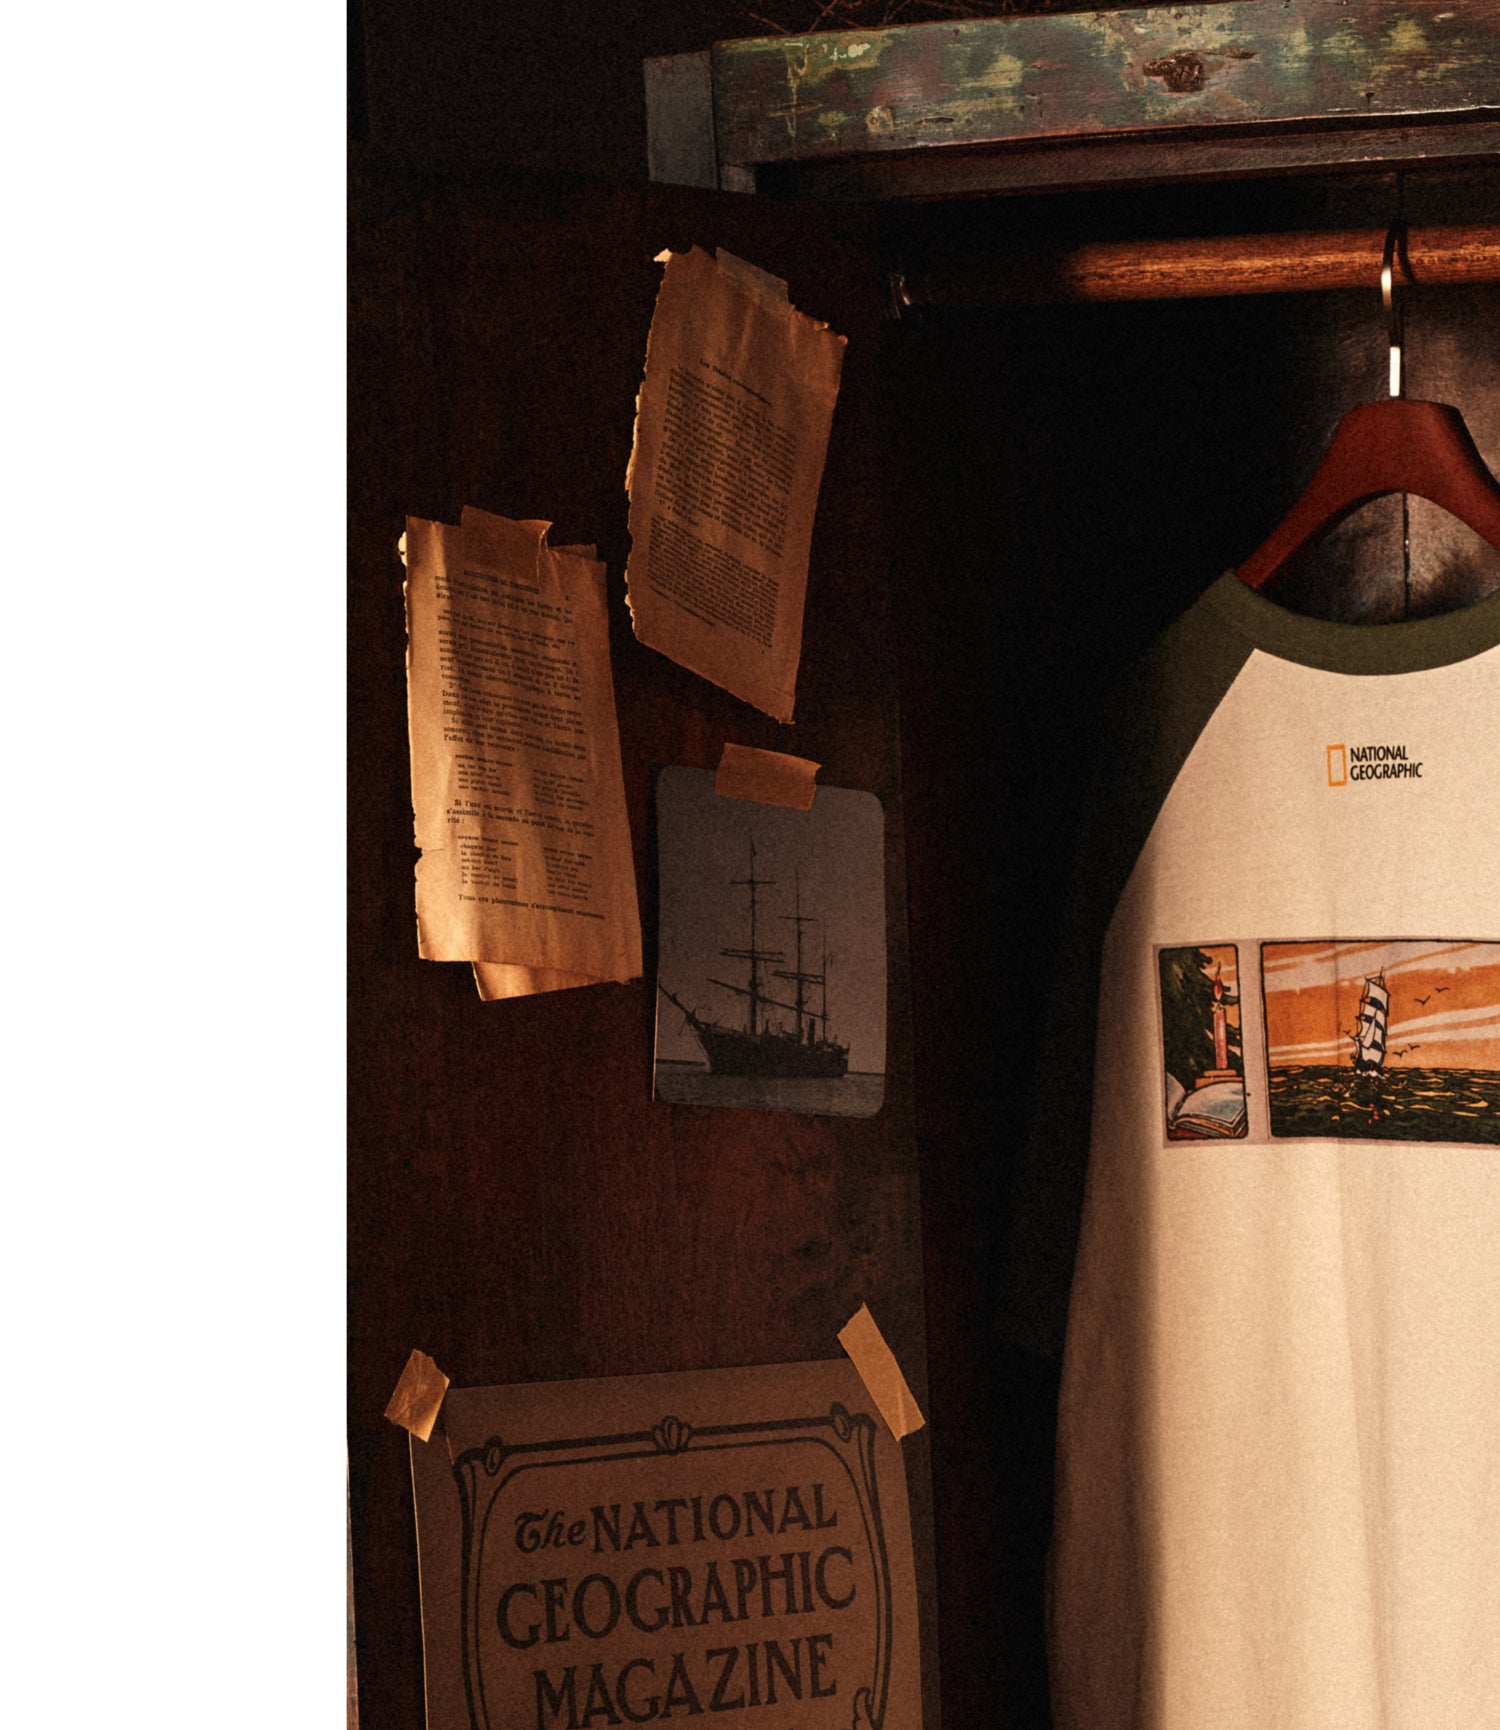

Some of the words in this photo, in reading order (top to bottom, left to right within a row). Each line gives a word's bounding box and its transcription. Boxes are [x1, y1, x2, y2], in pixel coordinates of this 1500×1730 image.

[1350, 745, 1408, 762] NATIONAL
[1350, 762, 1423, 781] GEOGRAPHIC
[514, 1508, 586, 1554] The
[591, 1483, 837, 1553] NATIONAL
[496, 1546, 857, 1649] GEOGRAPHIC
